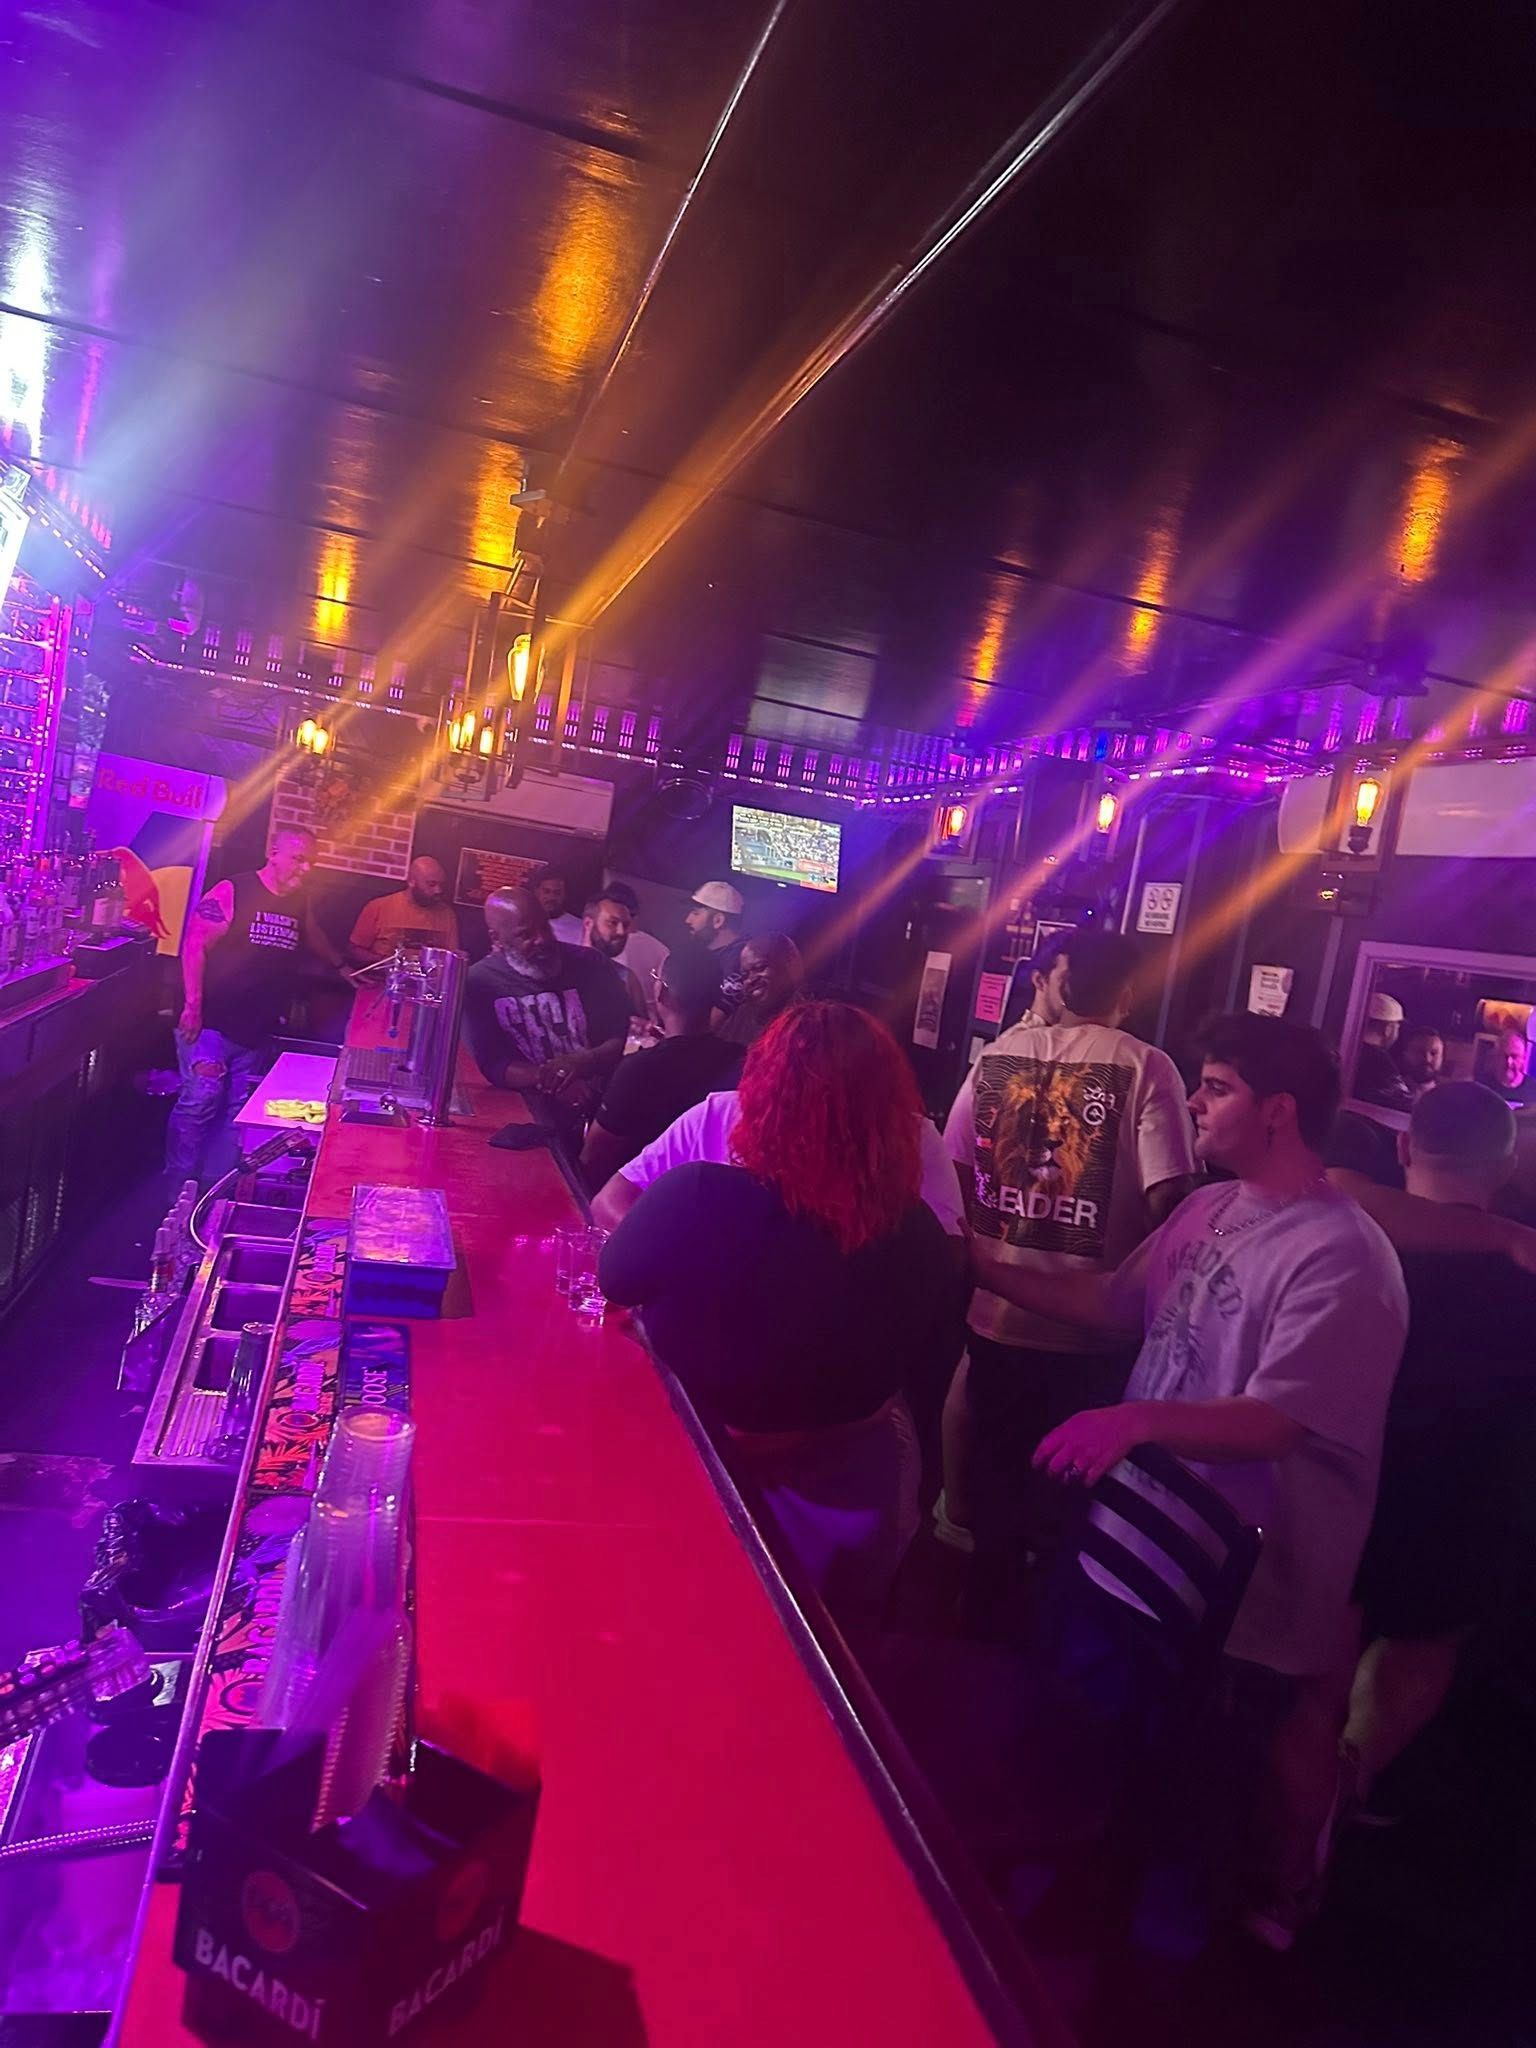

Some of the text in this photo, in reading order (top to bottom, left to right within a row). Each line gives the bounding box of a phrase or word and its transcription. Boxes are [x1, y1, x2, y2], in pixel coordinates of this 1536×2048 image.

[98, 767, 205, 809] Red Bull
[996, 1185, 1100, 1230] EADER
